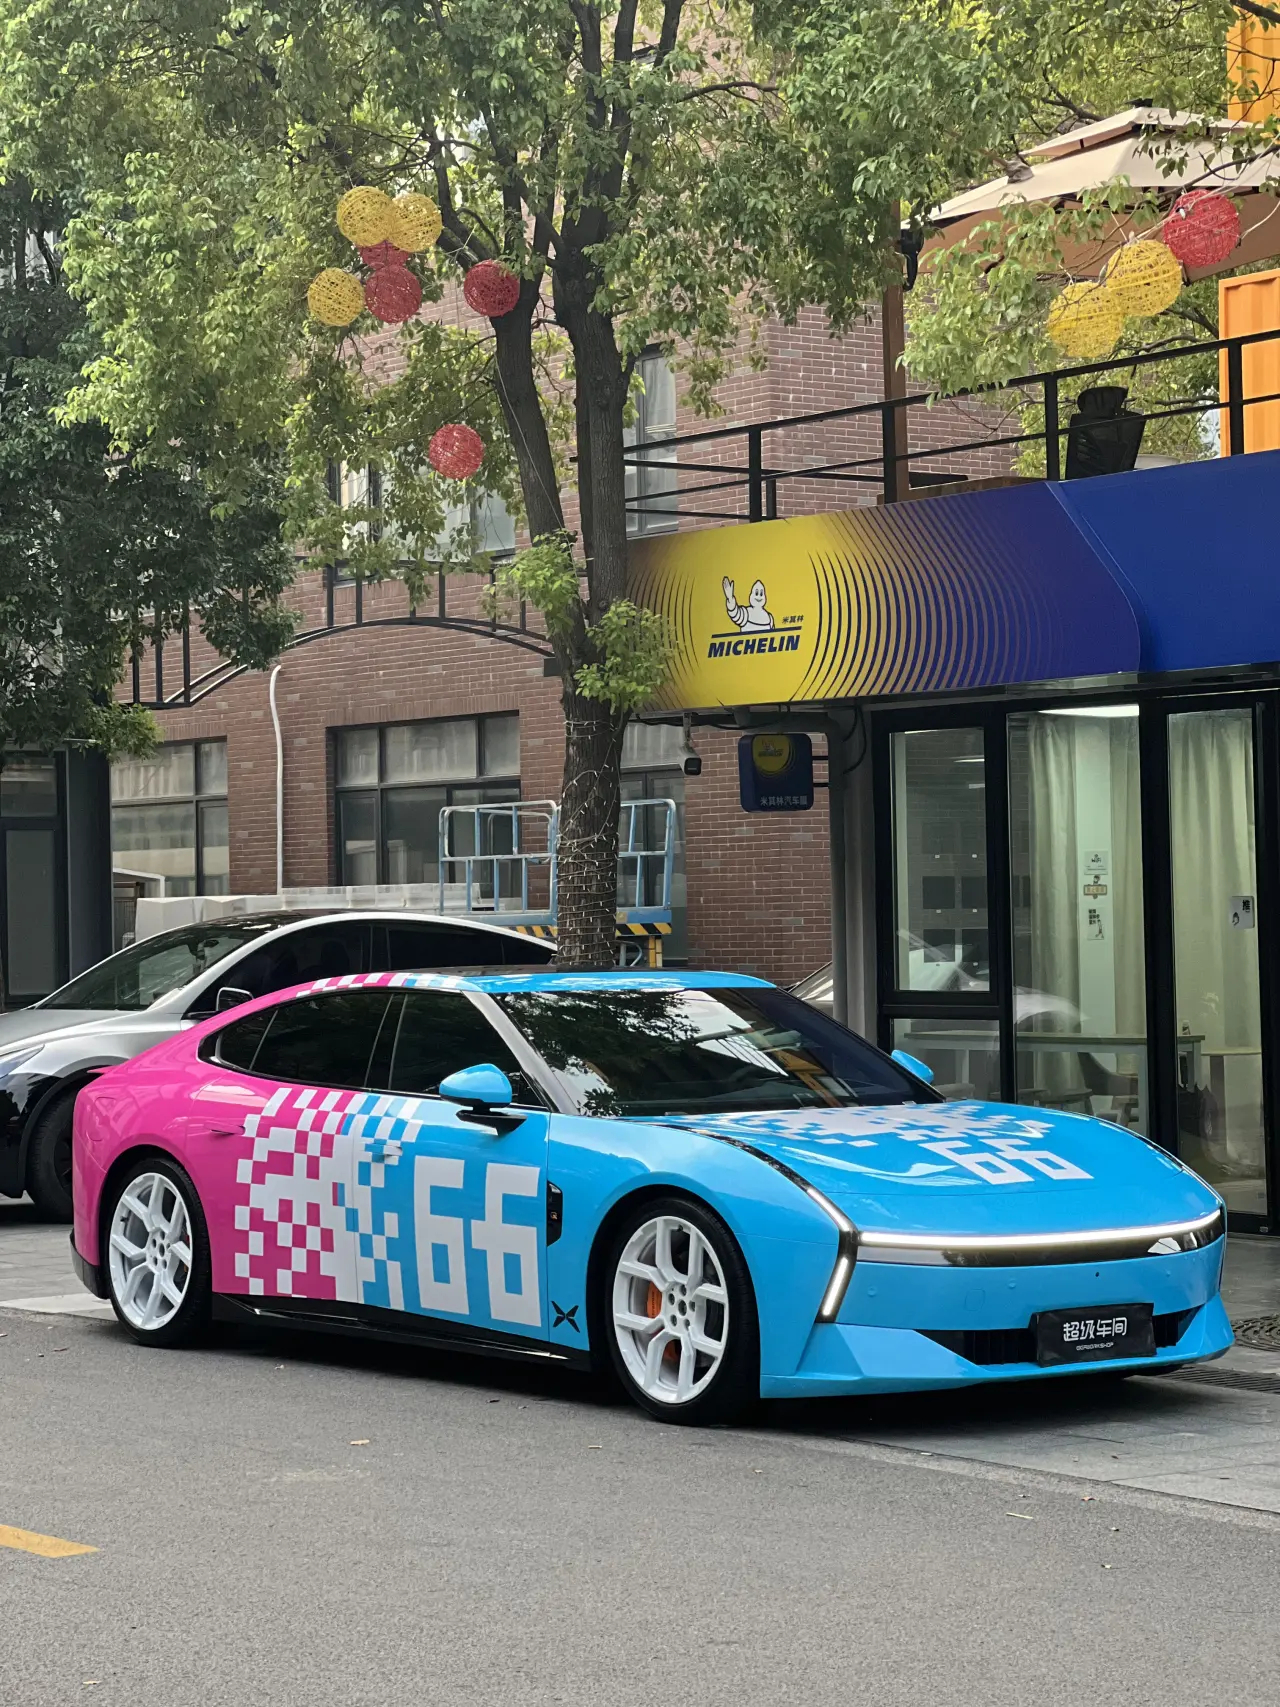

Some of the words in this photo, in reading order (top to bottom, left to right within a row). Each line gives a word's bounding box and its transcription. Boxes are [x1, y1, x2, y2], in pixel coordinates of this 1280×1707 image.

[707, 634, 801, 658] MICHELIN
[917, 1138, 1095, 1185] 66
[413, 1155, 542, 1327] 66
[1063, 1317, 1127, 1341] 超级车间
